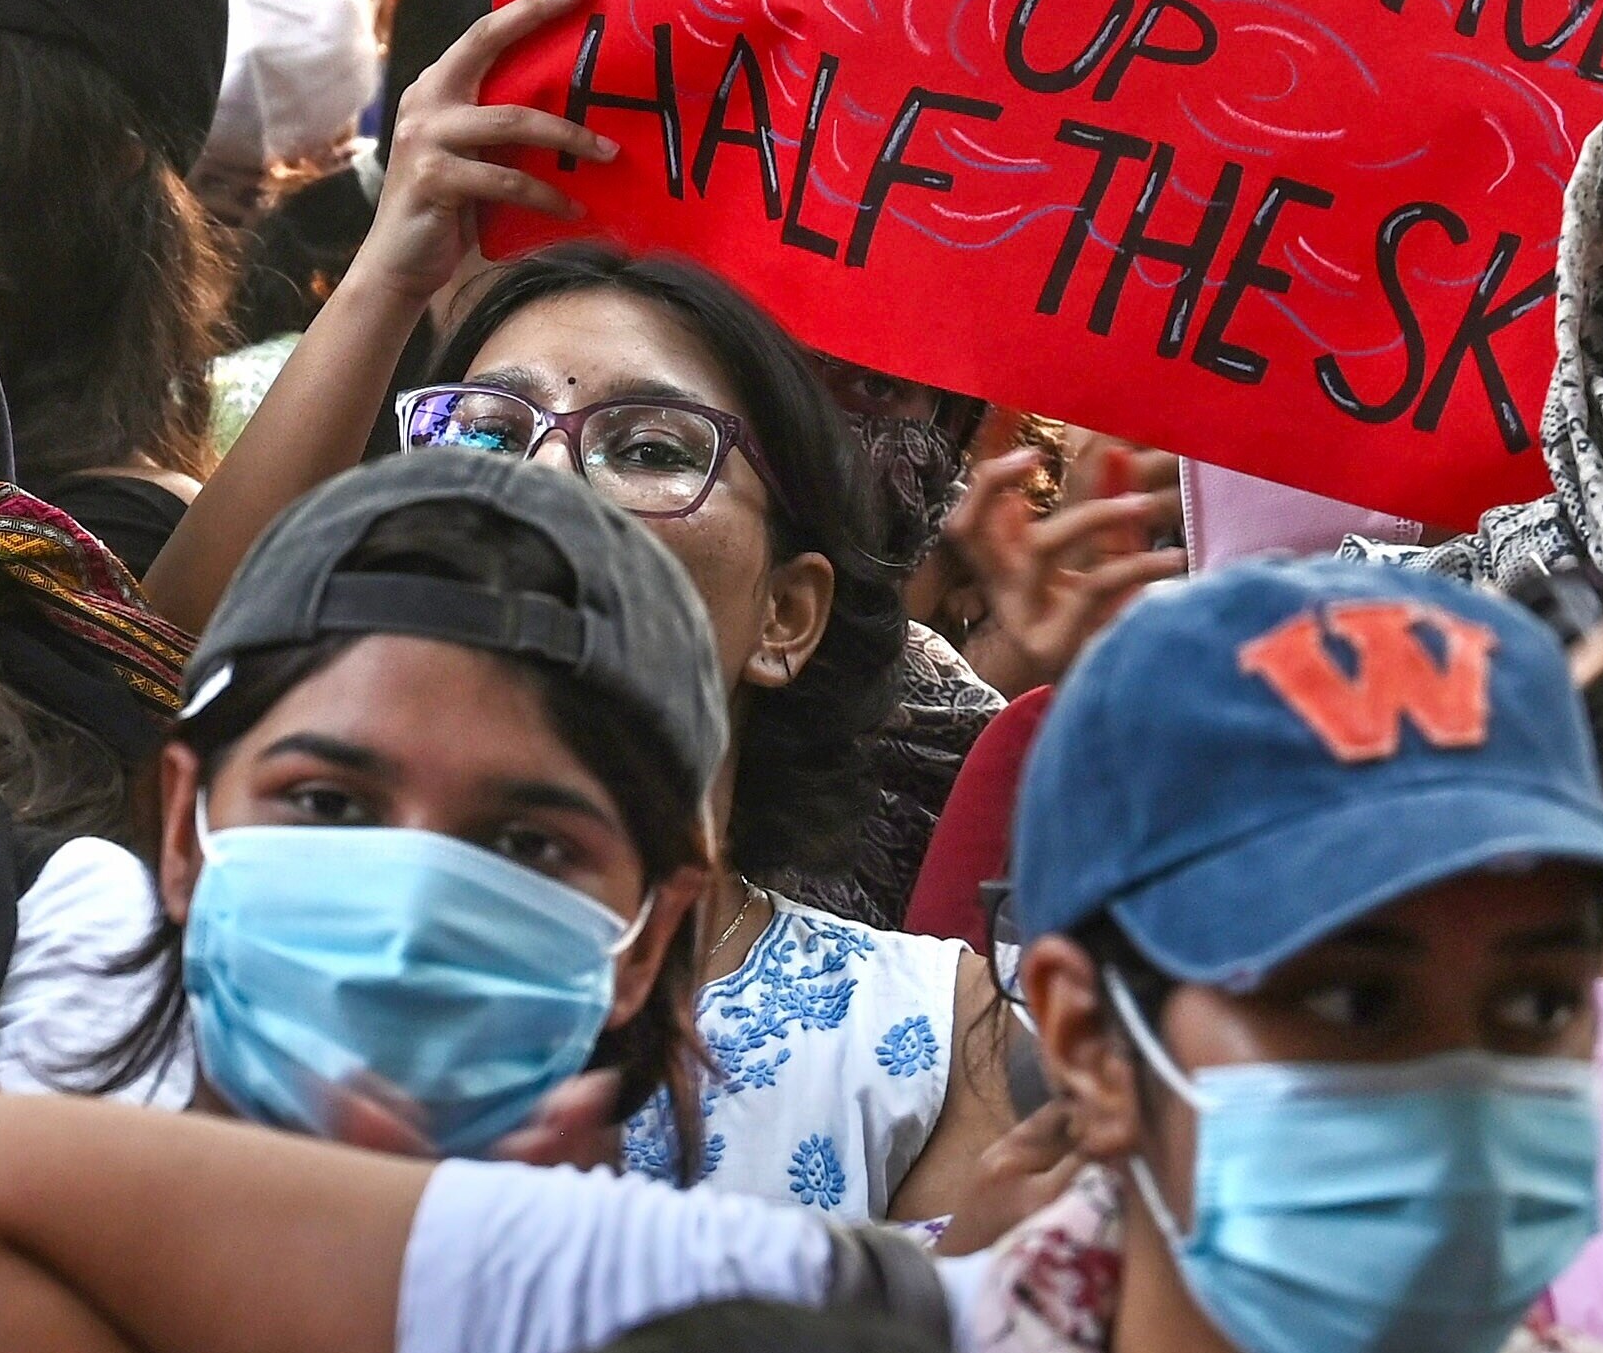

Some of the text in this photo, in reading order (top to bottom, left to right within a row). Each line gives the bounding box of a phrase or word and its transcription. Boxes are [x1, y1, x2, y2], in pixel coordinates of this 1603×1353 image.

[555, 14, 1557, 455] HALF THE SK
[1237, 600, 1497, 762] W
